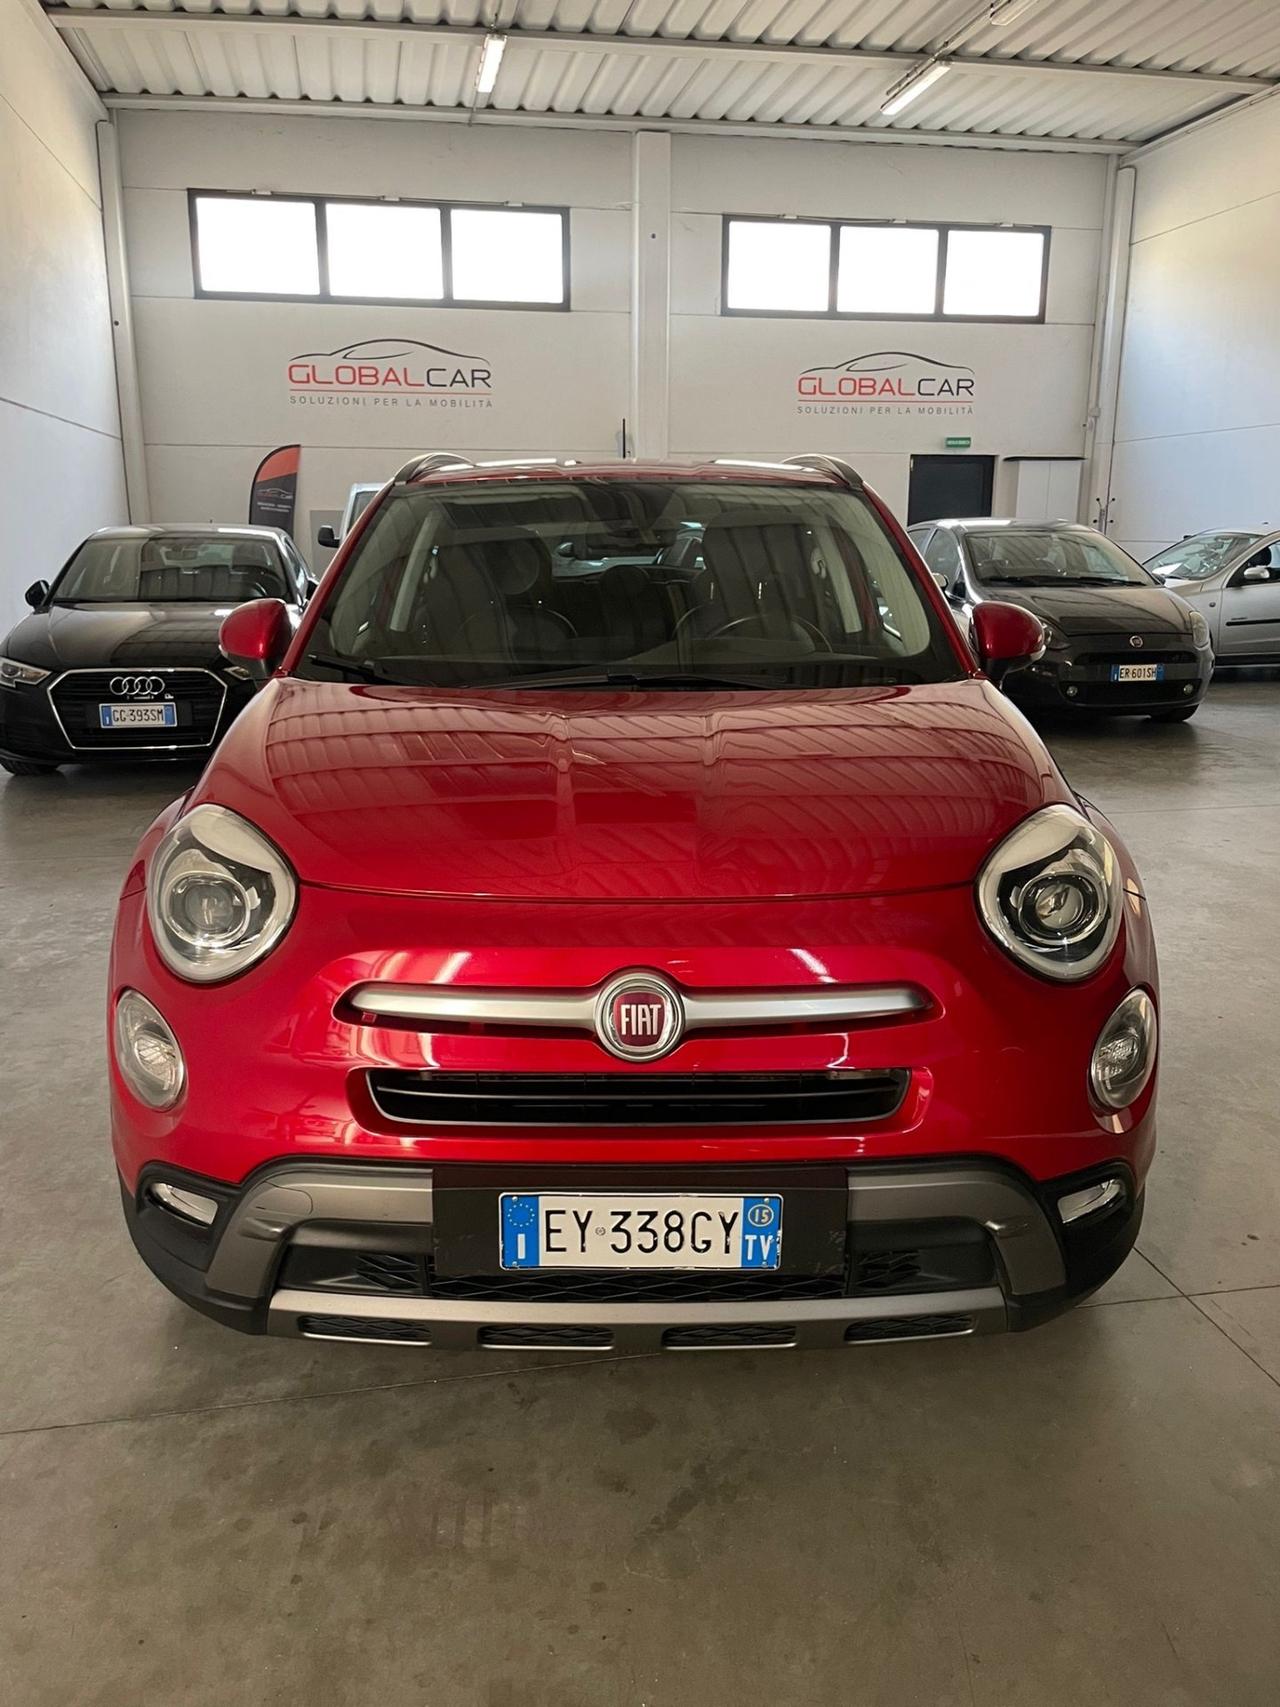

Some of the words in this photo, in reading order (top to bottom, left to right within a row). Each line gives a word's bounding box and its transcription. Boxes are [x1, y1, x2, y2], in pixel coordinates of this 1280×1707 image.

[288, 364, 492, 388] GLOBALCAR
[798, 377, 975, 396] GLOBALCAR
[289, 395, 366, 406] SOLUZIONI
[374, 397, 398, 407] PER
[406, 398, 421, 407] LA
[797, 406, 863, 415] SOLUZIONI
[870, 406, 891, 415] PER
[898, 407, 911, 415] LA
[129, 708, 164, 722] 393SM
[620, 1004, 662, 1036] FIAT
[754, 1208, 770, 1223] 15
[517, 1233, 526, 1260] I
[545, 1209, 593, 1253] EY
[610, 1209, 739, 1254] 338GY
[745, 1234, 774, 1261] TV
